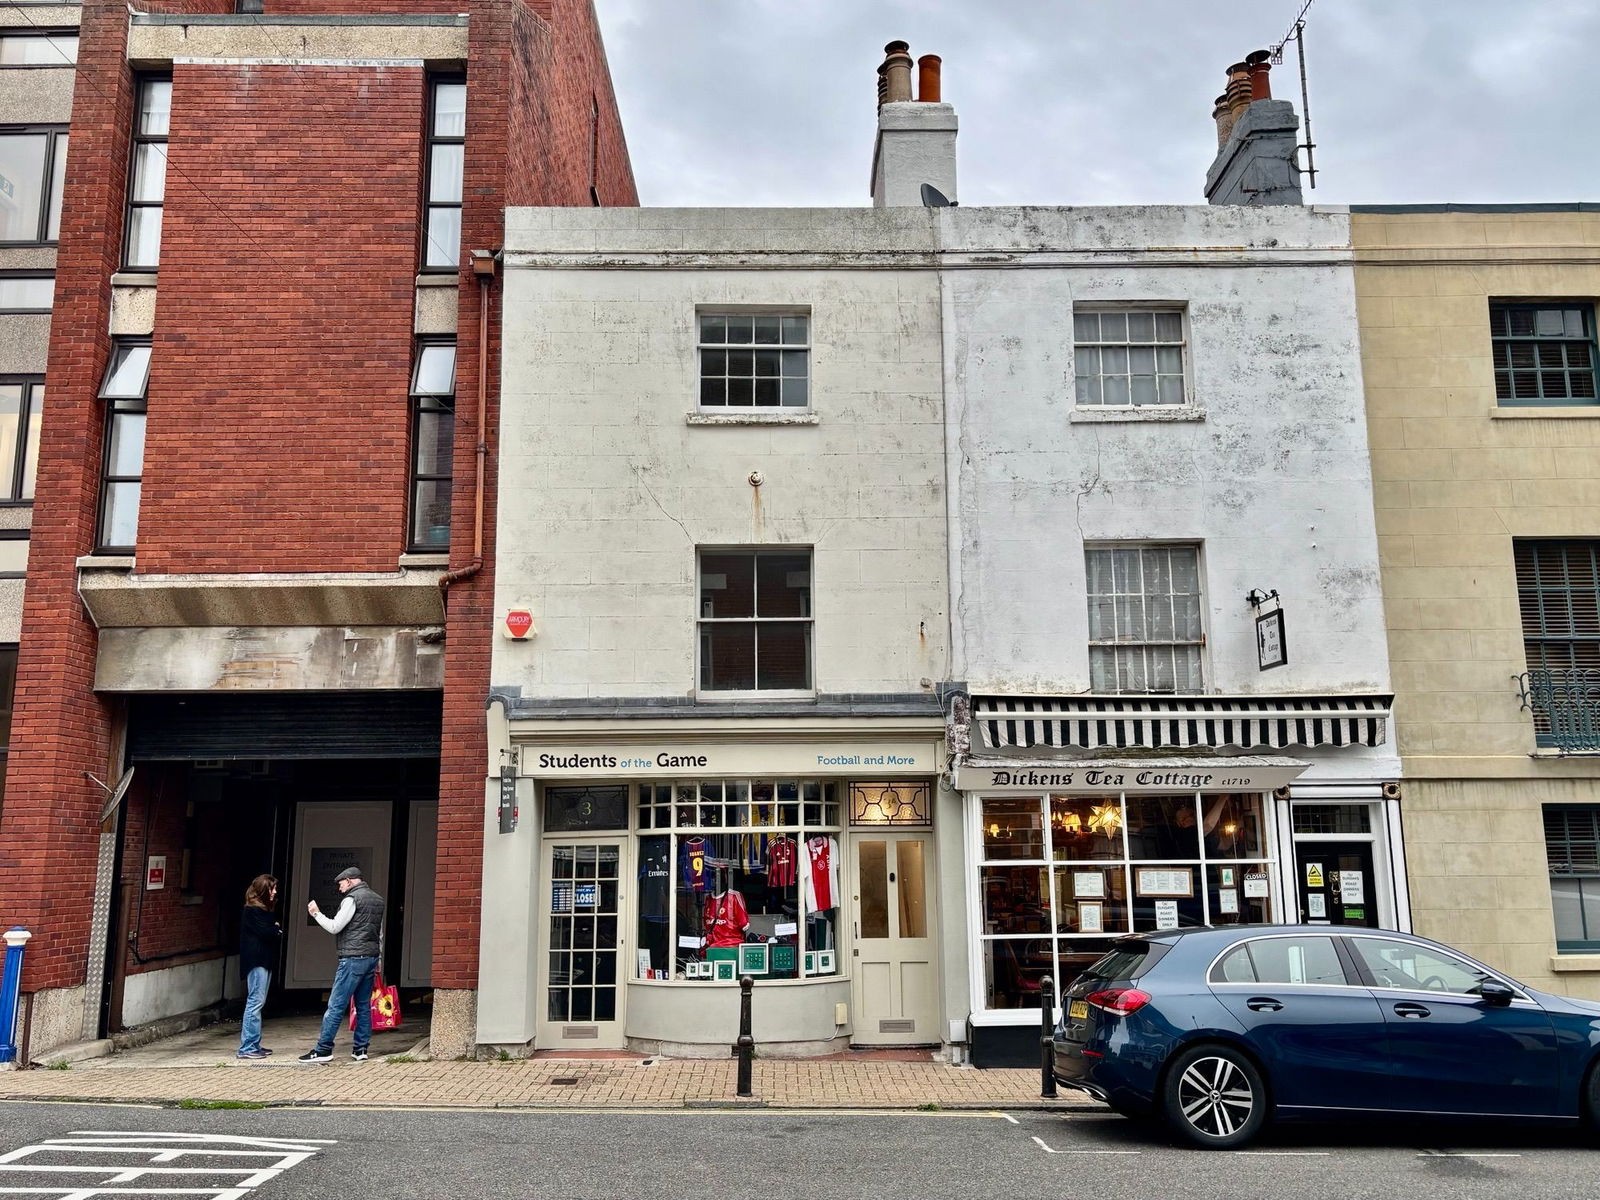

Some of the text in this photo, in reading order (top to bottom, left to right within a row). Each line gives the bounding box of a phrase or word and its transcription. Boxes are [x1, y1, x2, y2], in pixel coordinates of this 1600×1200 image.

[539, 753, 708, 768] Students of the Game
[817, 755, 915, 765] Football and More
[991, 769, 1074, 786] Dickens
[1085, 770, 1124, 785] Tea
[1136, 770, 1213, 787] Cottage
[582, 801, 592, 816] 3
[692, 857, 703, 877] 9
